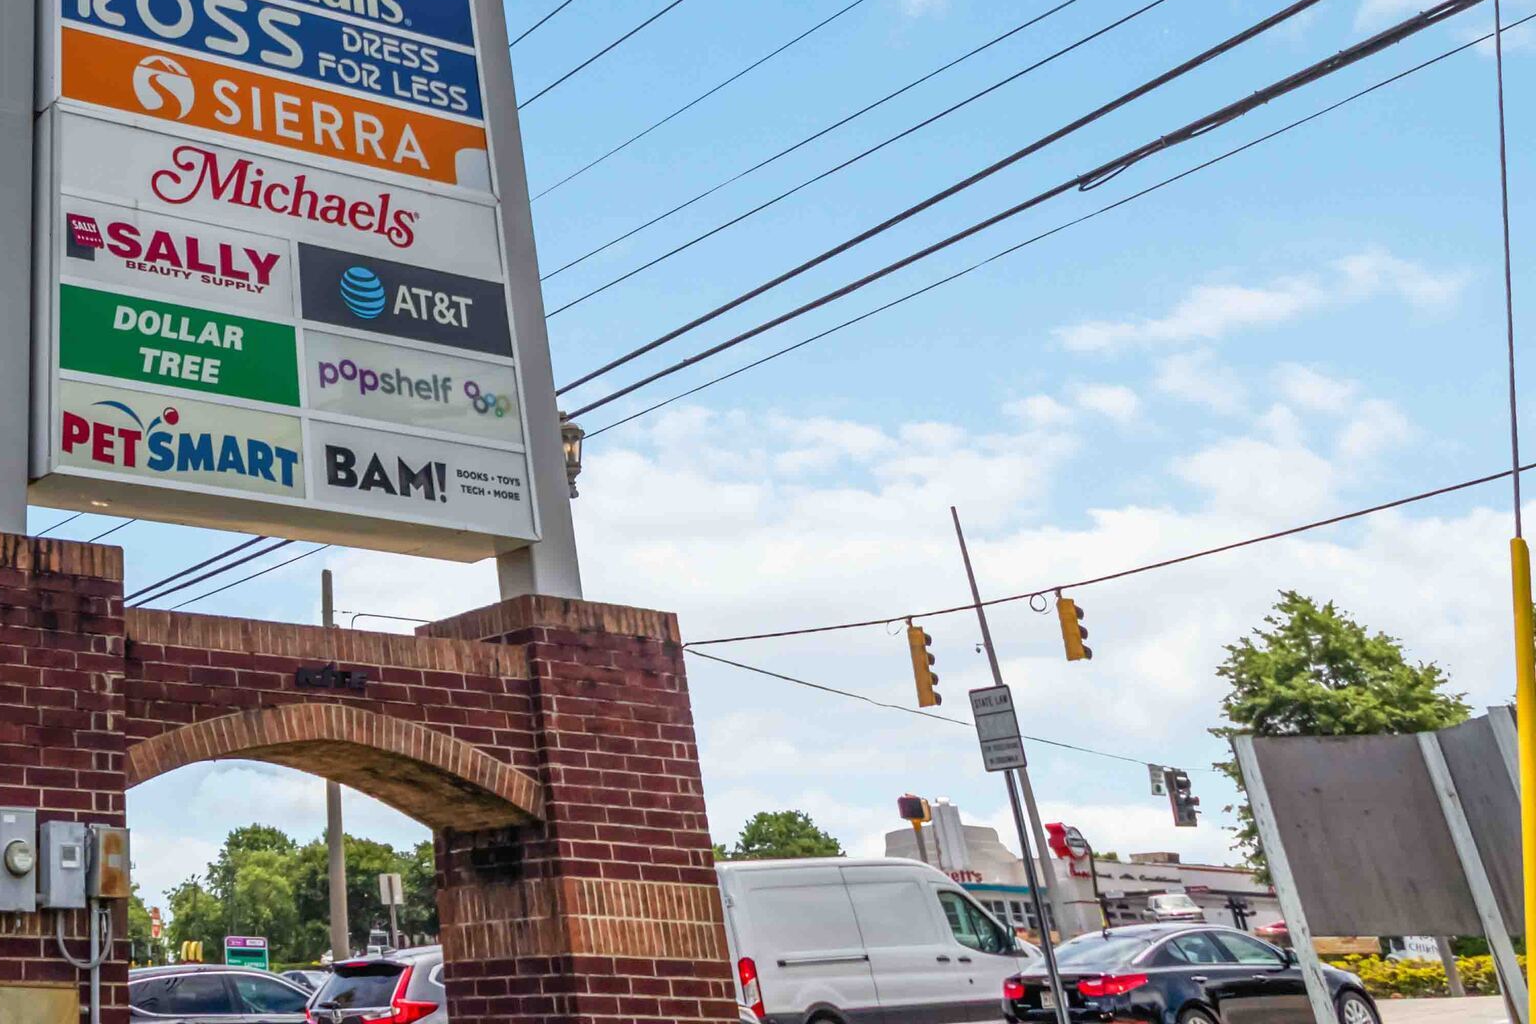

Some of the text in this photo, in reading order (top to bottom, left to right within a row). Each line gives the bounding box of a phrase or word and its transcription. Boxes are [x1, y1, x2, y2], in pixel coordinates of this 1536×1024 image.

[343, 27, 440, 73] DRESS
[318, 52, 468, 112] FOR LESS
[212, 79, 430, 170] SIERRA
[151, 145, 416, 248] Michaels
[72, 219, 97, 233] SALLY
[106, 222, 281, 285] SALLY
[125, 260, 265, 294] BEAUTY SUPPLY
[113, 306, 245, 351] DOLLAR
[393, 285, 473, 328] AT&T
[139, 347, 222, 384] TREE
[318, 359, 453, 404] popshelf
[325, 444, 447, 503] BAM!
[456, 469, 520, 487] BOOKS TOYS
[460, 484, 520, 501] TECH MORE
[974, 694, 1008, 709] STATE LAW
